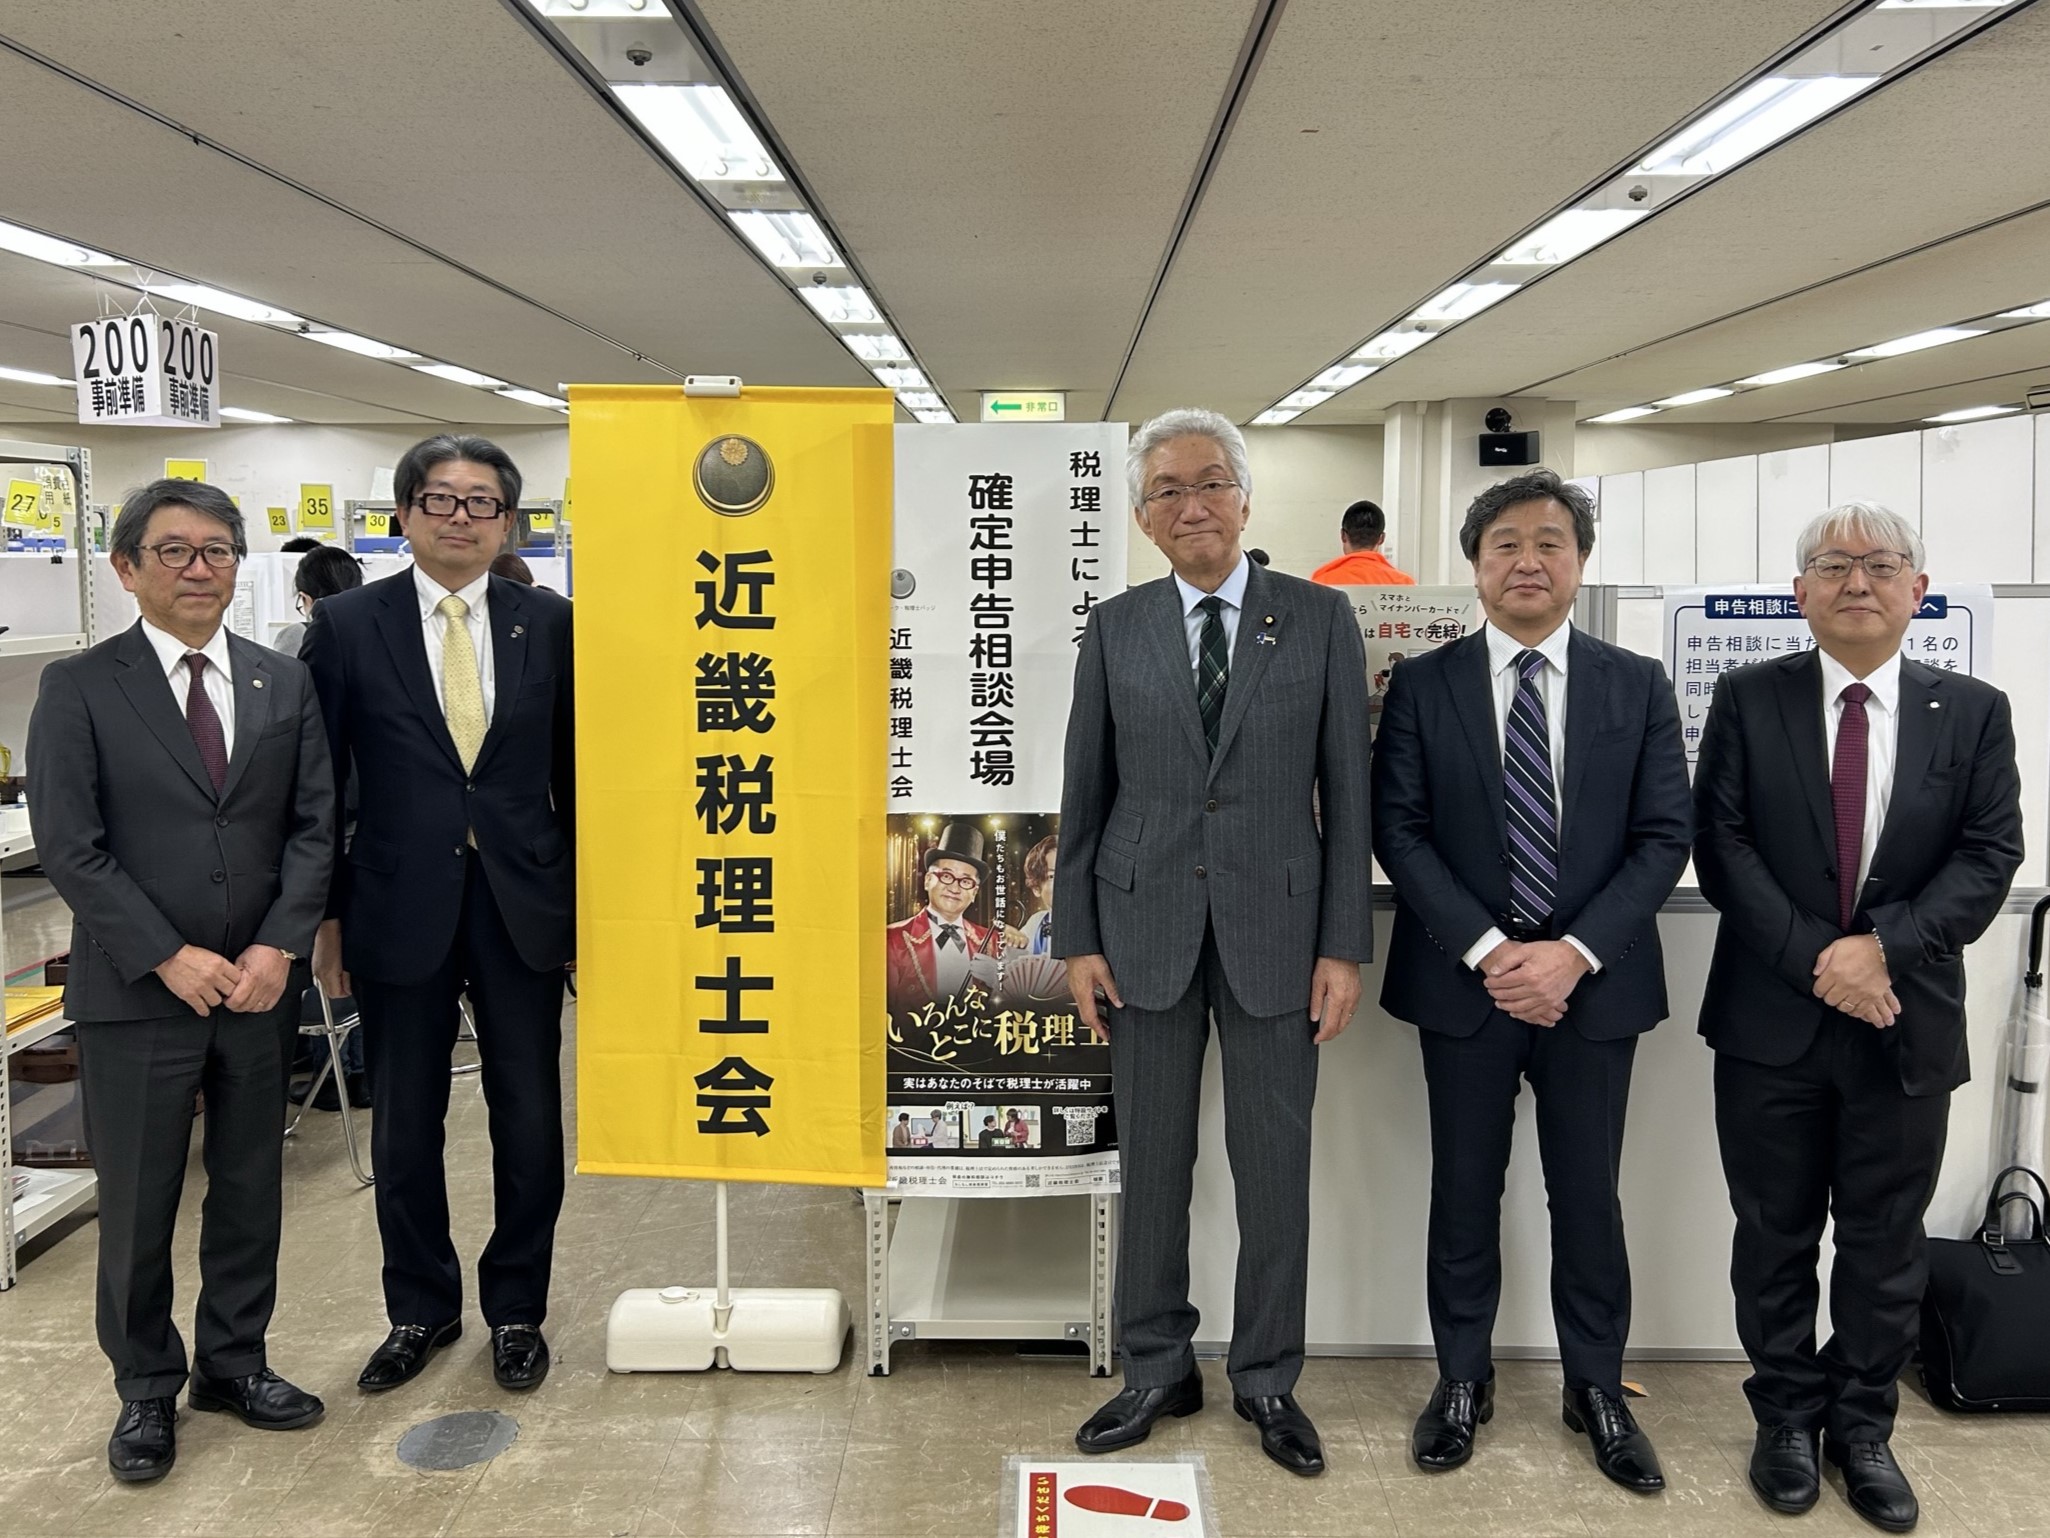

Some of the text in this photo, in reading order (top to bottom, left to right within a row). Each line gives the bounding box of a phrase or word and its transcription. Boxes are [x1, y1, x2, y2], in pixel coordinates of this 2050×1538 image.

[79, 317, 149, 379] 200
[162, 320, 213, 385] 200
[91, 375, 146, 417] 事前準備
[169, 377, 210, 422] 事前準備
[1026, 402, 1058, 412] 非常口
[11, 494, 36, 512] 27
[307, 498, 329, 516] 35
[271, 516, 286, 526] 23
[370, 515, 386, 527] 30
[1379, 593, 1411, 602] スマホと
[1379, 604, 1460, 614] マイナンバーカードで
[1714, 598, 1799, 616] 申告相談に
[968, 472, 1015, 787] 確定申告相談会場
[889, 627, 914, 798] 近畿税理士会
[694, 549, 777, 1138] 近畿税理士会
[902, 1077, 1092, 1091] 実はあなたのそばで税理士が活躍中
[1035, 1476, 1051, 1538] 待ちください
